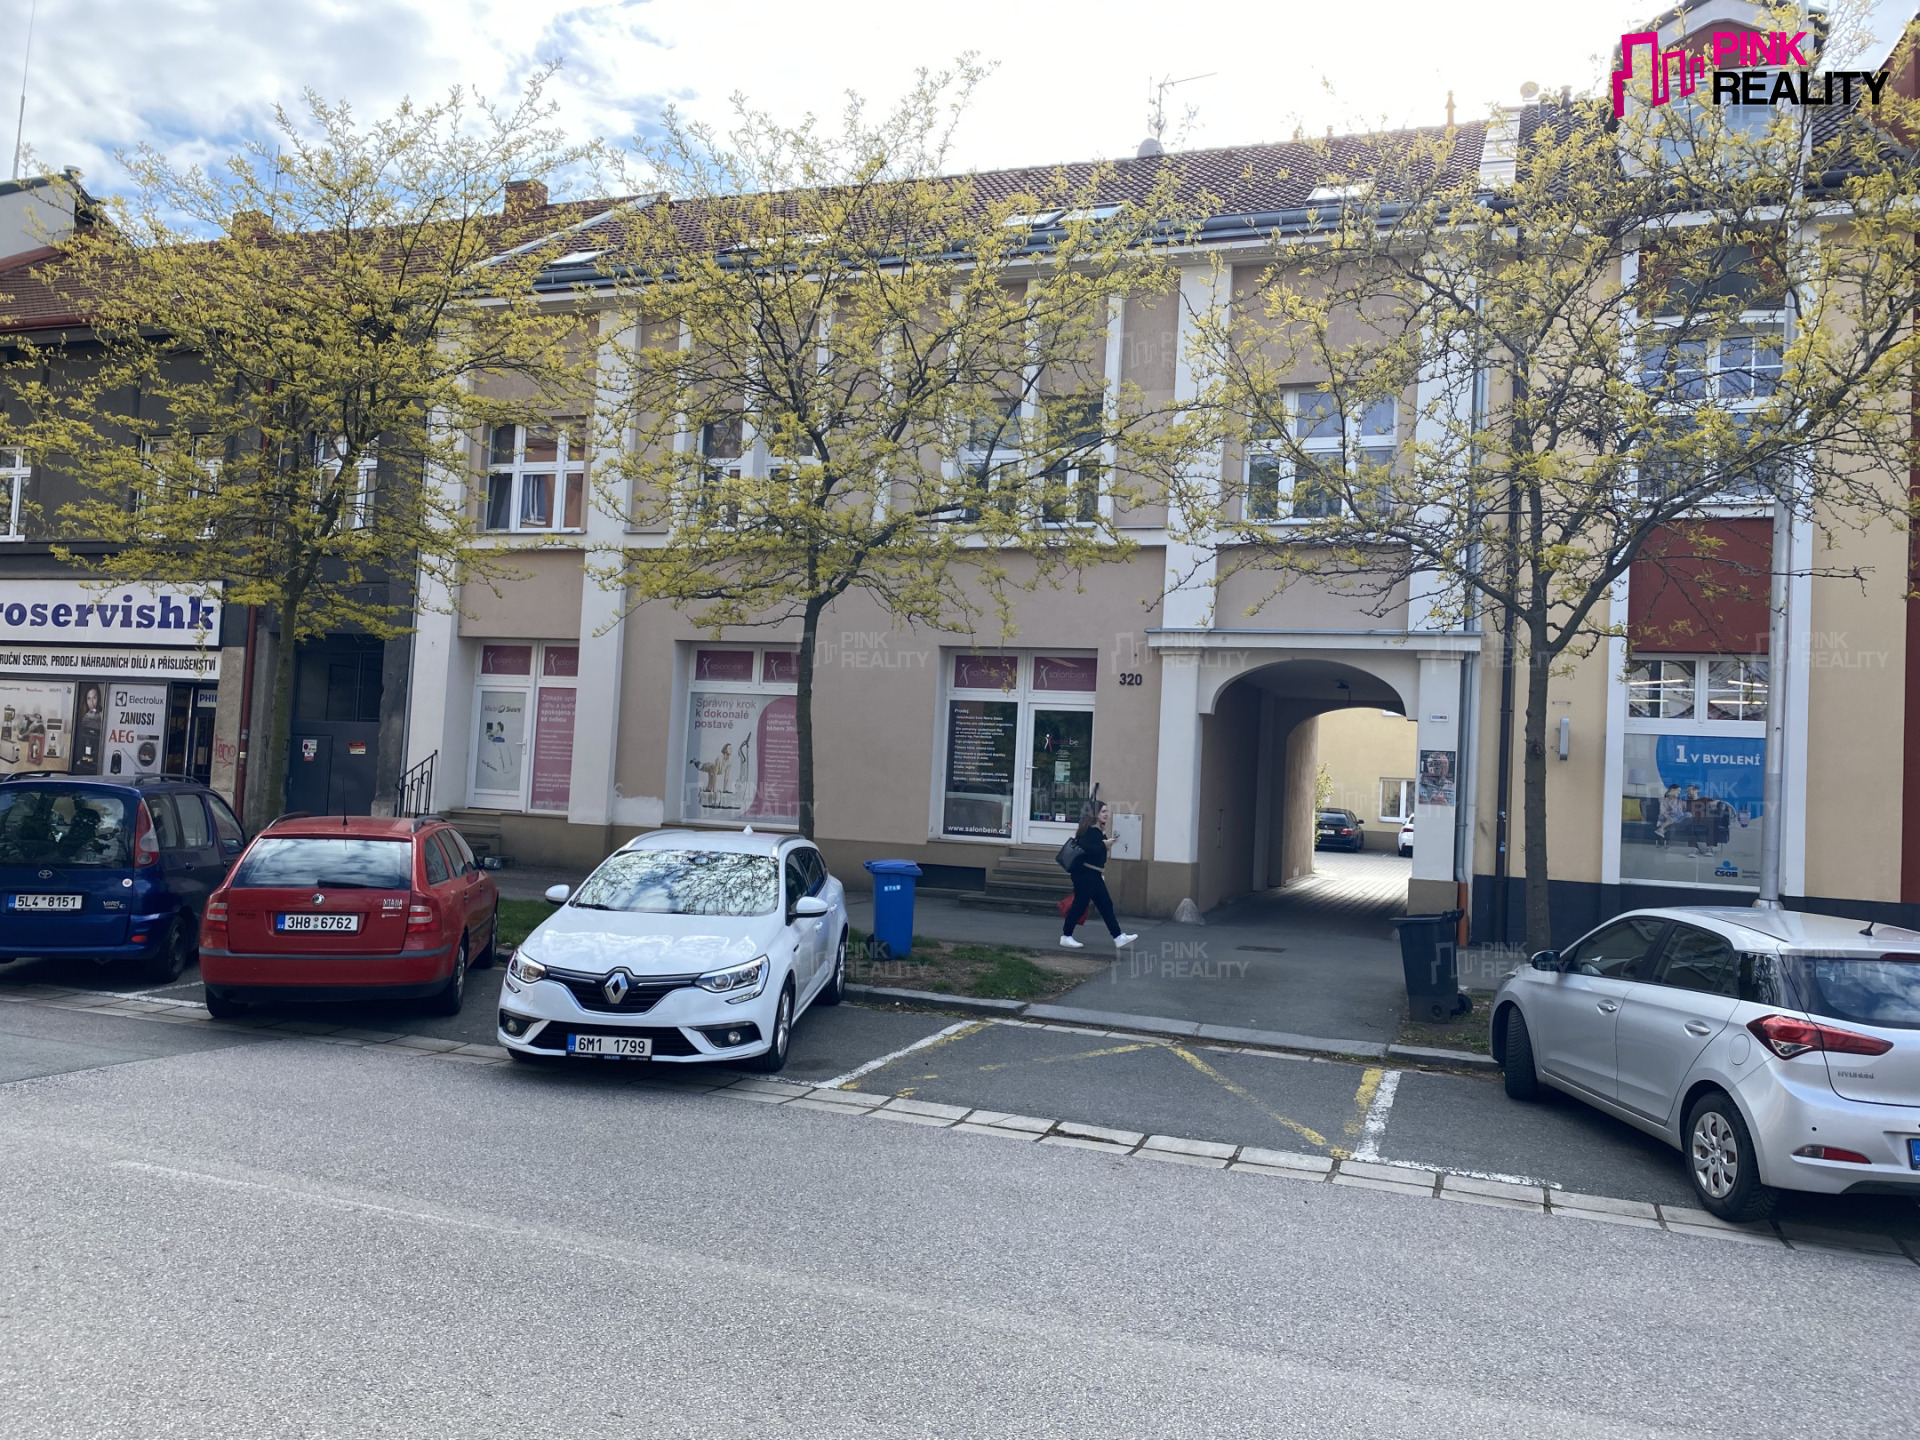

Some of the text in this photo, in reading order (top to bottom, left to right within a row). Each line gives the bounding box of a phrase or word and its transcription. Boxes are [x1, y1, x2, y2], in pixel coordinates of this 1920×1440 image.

[22, 654, 48, 667] SERVIS,
[51, 655, 78, 668] PRODEJ
[81, 654, 129, 669] NÁHRADNÍCH
[131, 655, 147, 669] DÍLŮ
[150, 658, 155, 669] A
[158, 655, 216, 671] PŘÍSLUŠENSTVÍ
[1119, 673, 1142, 686] 320
[129, 695, 164, 705] Electrolux
[696, 698, 756, 710] Správný krok
[120, 712, 155, 725] ZANUSSI
[696, 709, 749, 719] k dokonalé
[695, 720, 734, 730] postavě
[109, 730, 135, 743] AEG
[1676, 745, 1760, 765] 1 V BYDLENÍ
[948, 826, 1006, 834] www.salonbein.cz
[18, 896, 38, 907] 5L4
[50, 896, 76, 907] 8151
[288, 917, 310, 929] 3H8
[321, 917, 351, 929] 6762
[578, 1037, 602, 1051] 6M1
[614, 1039, 645, 1053] 1799
